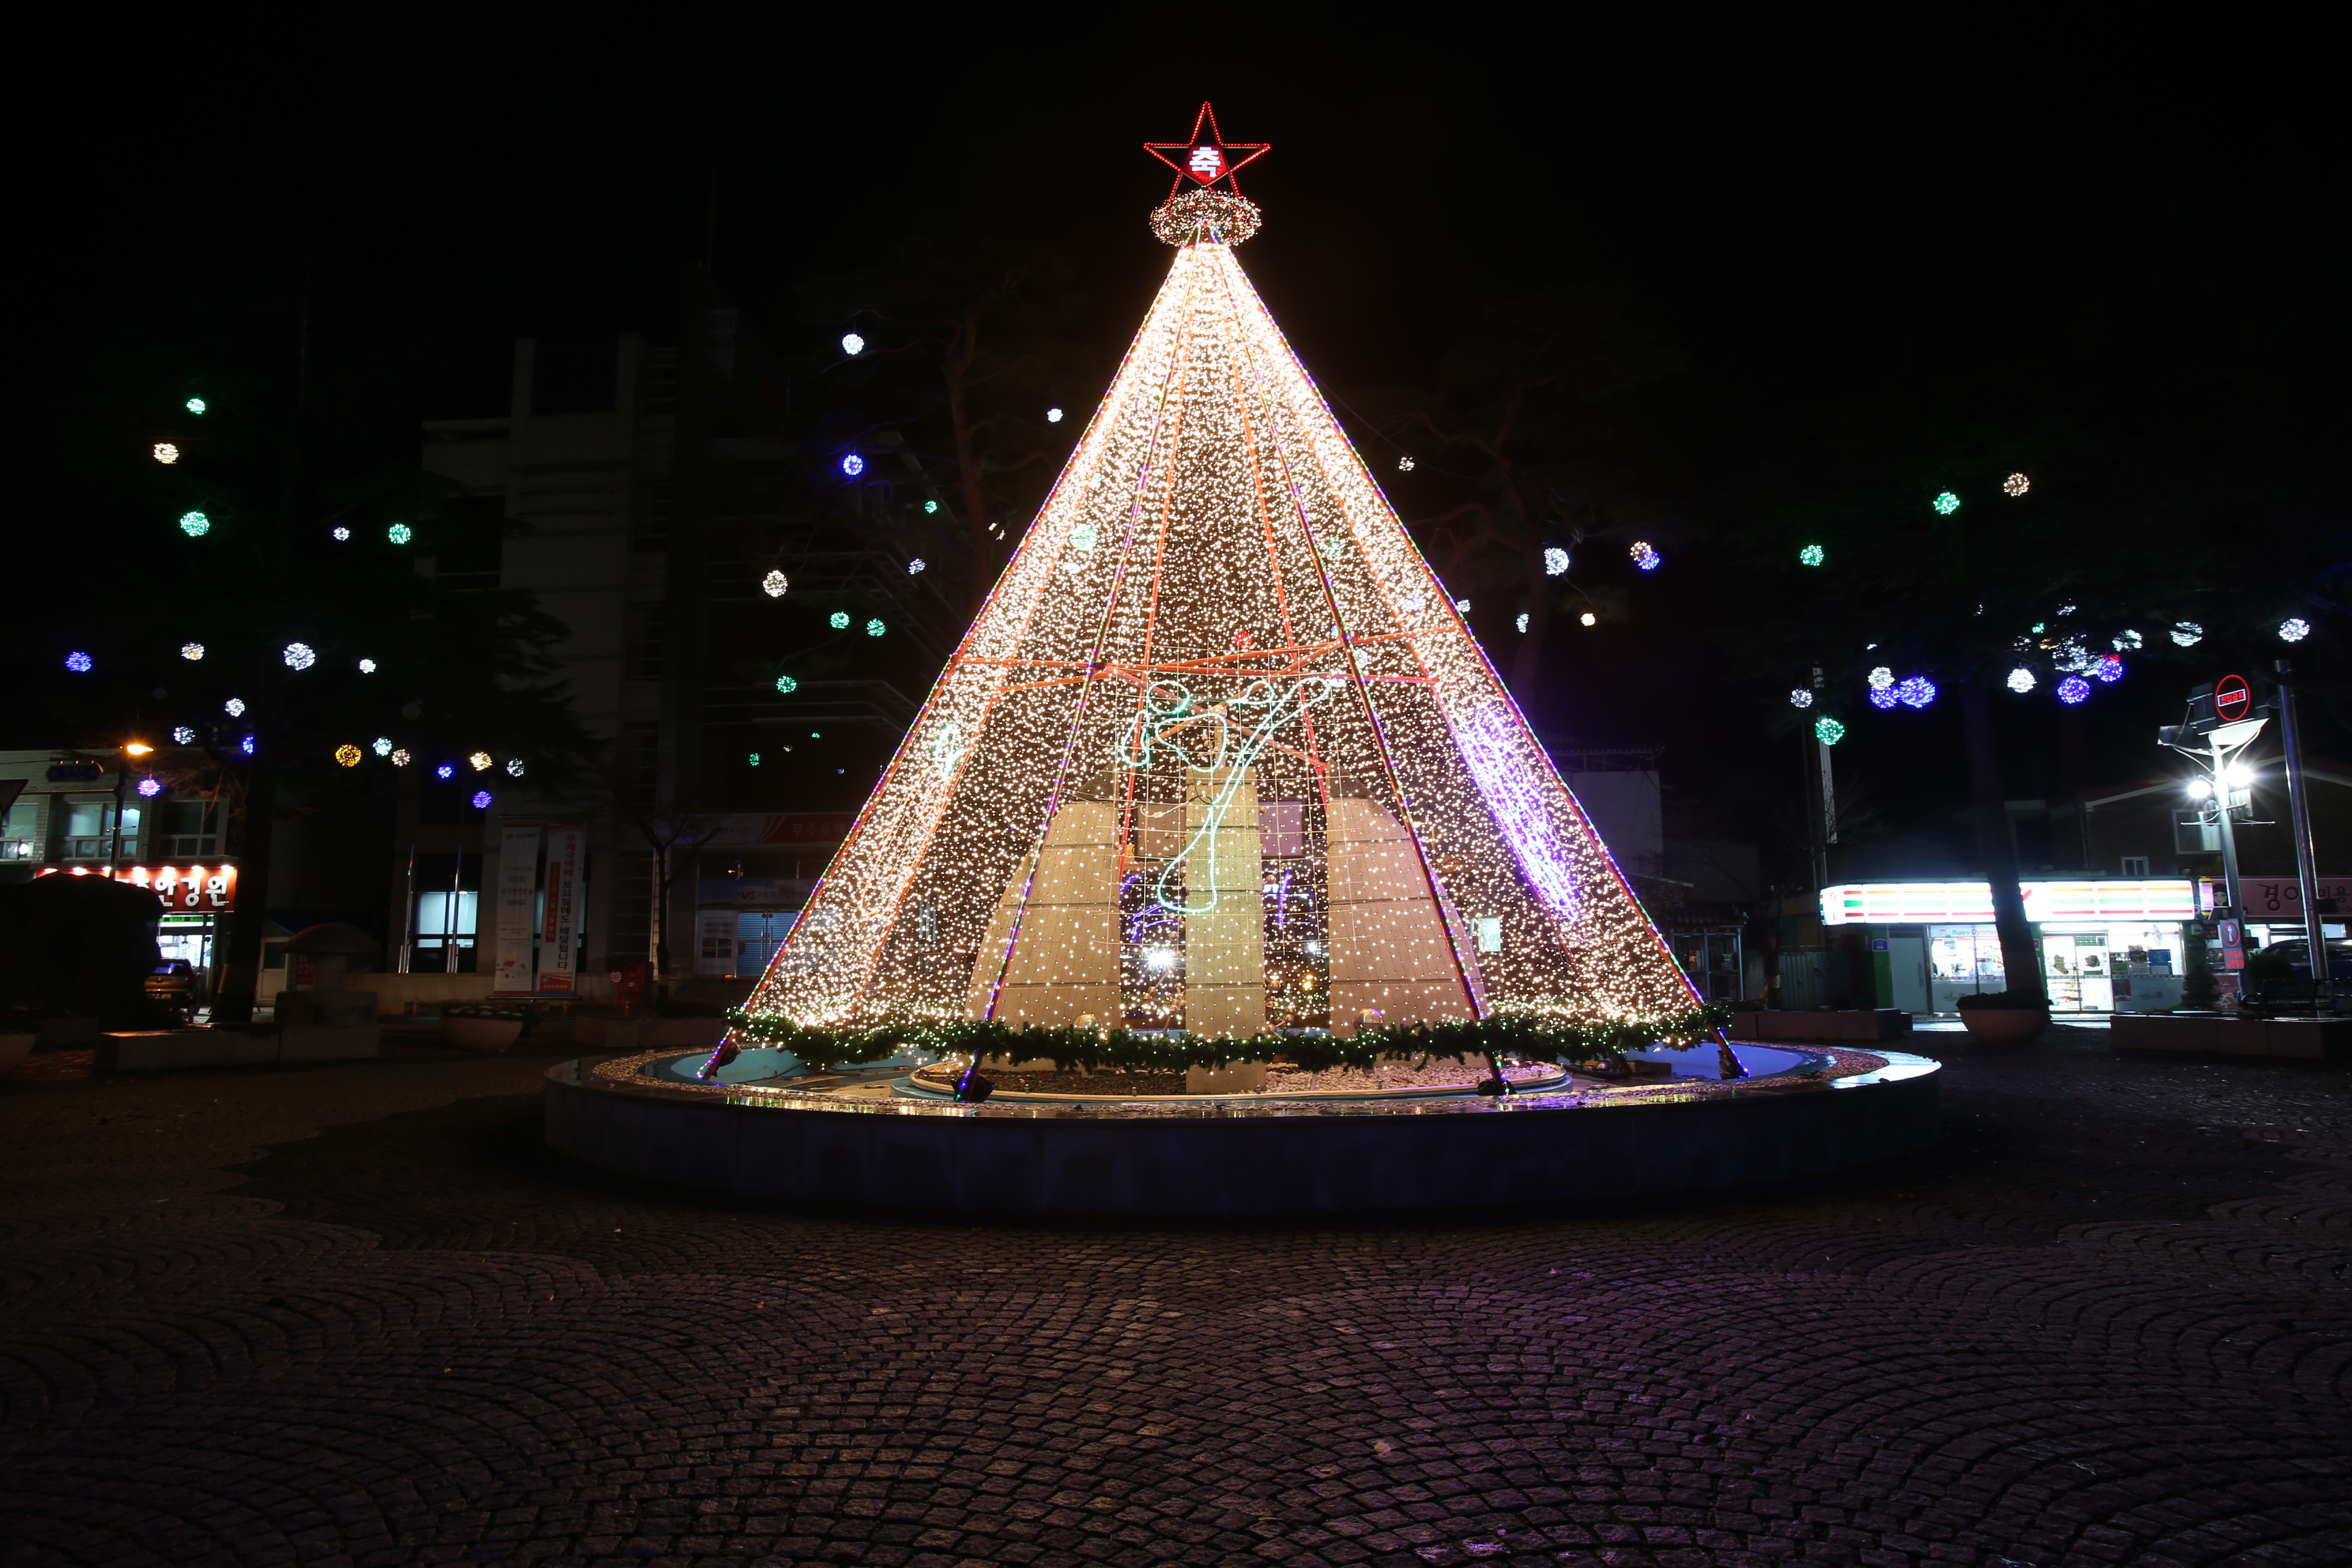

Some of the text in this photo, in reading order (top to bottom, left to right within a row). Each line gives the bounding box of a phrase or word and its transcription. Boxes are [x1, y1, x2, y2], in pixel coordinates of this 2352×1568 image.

[1188, 146, 1221, 178] 축
[2220, 691, 2244, 704] 진입금지
[791, 823, 849, 836] 무주우체
[557, 834, 576, 970] 우체국택배 토요일에도 배달됩니다
[2318, 886, 2352, 903] 미용
